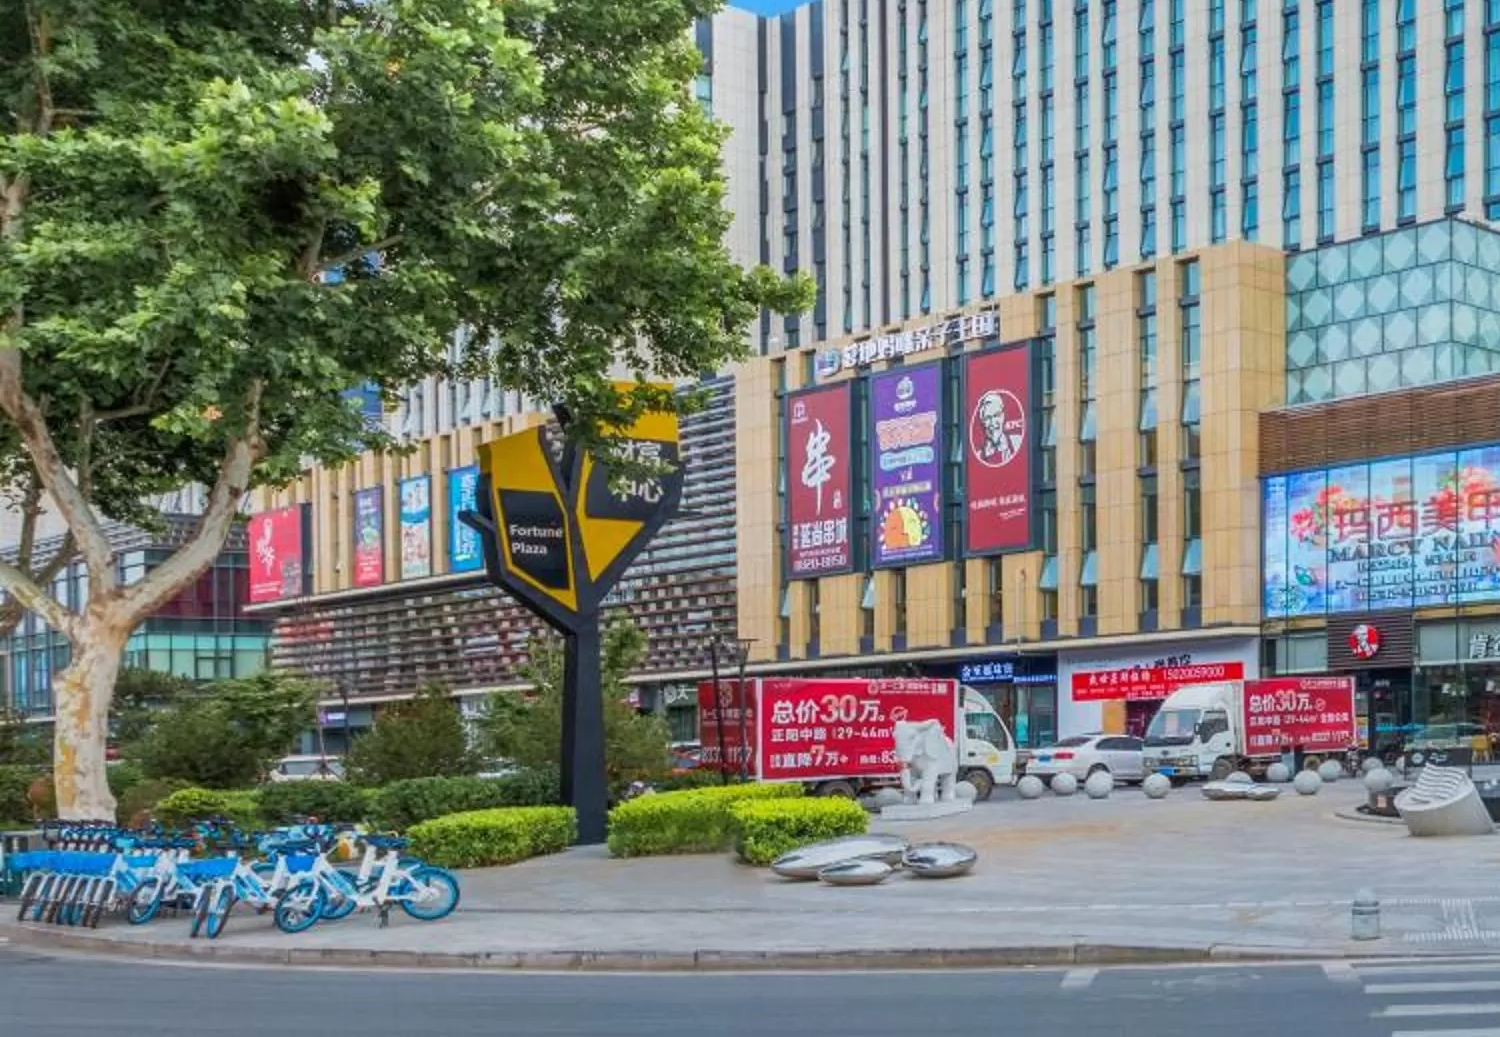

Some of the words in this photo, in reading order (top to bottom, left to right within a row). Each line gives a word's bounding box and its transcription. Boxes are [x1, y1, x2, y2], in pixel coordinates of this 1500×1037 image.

[611, 476, 664, 503] 中心
[510, 524, 563, 539] Fortune
[511, 542, 548, 555] Plaza
